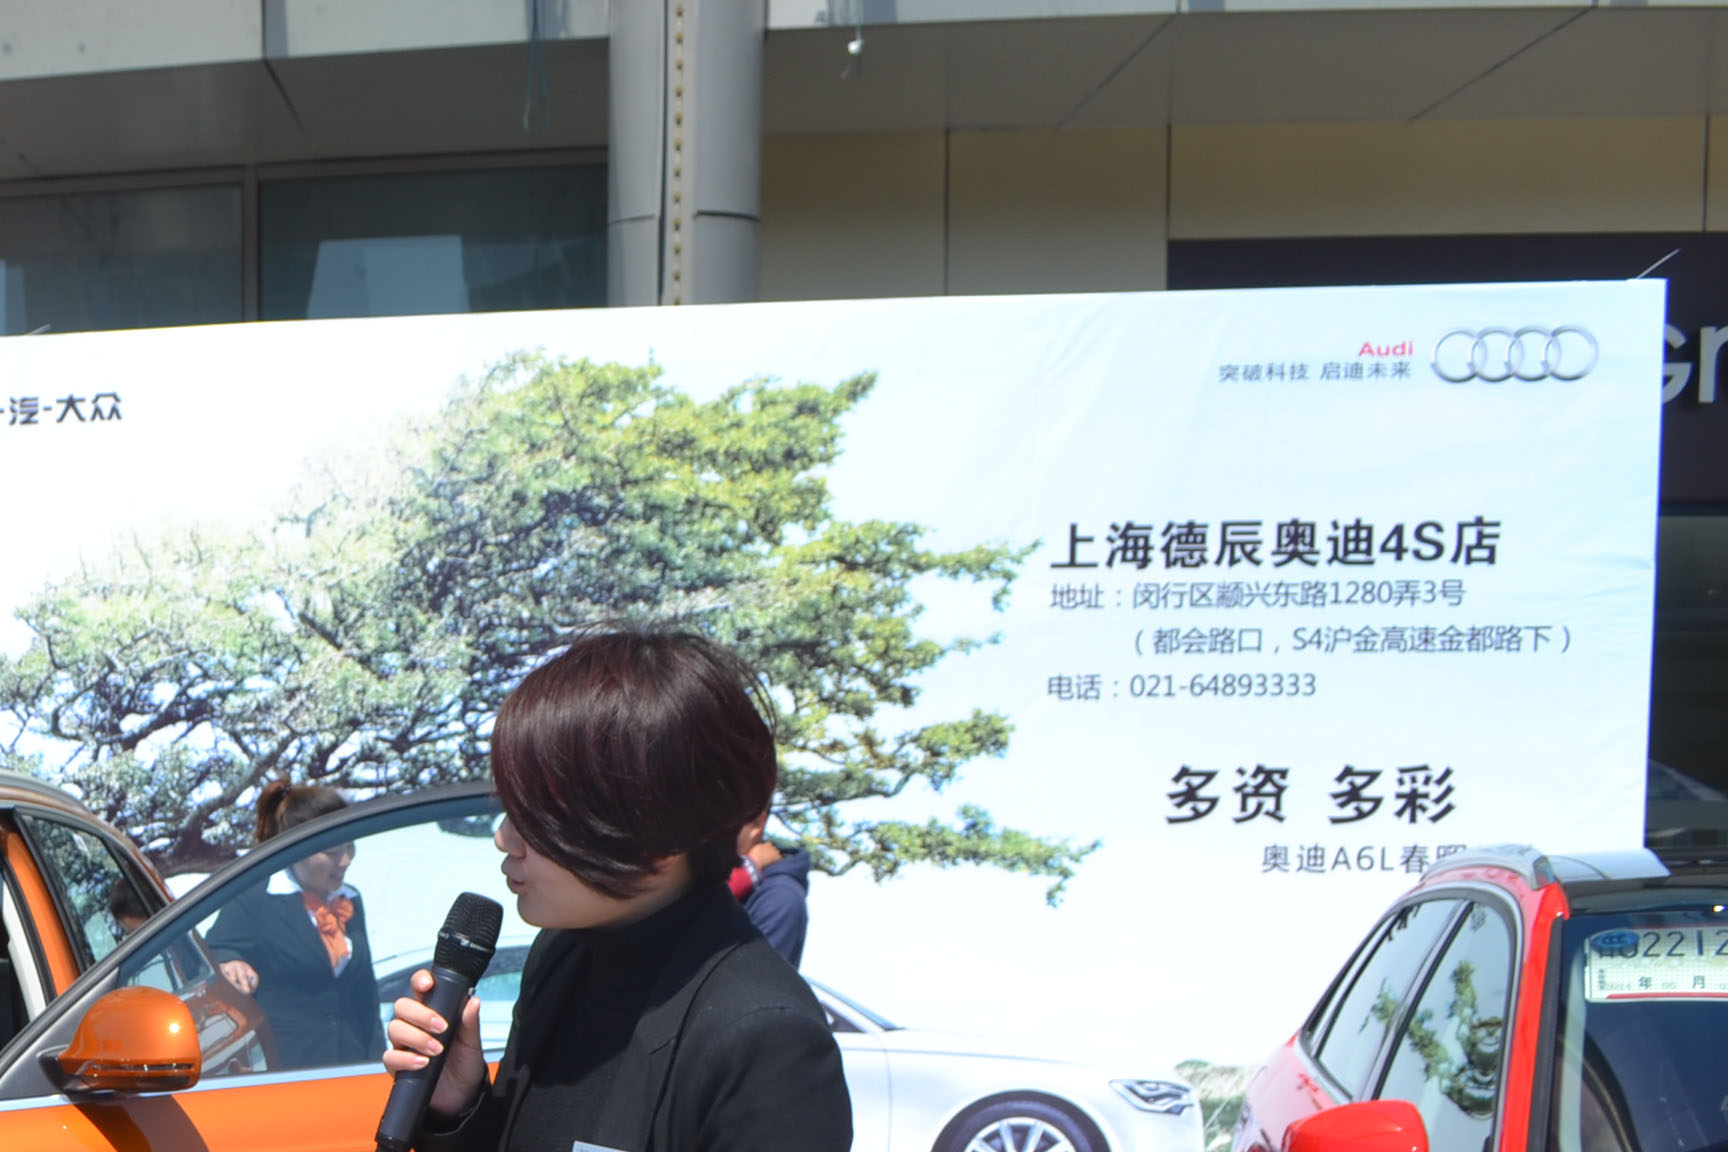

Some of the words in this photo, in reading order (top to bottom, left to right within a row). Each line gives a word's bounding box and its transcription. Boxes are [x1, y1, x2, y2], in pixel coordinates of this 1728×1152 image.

[1358, 341, 1414, 357] Audi
[1219, 363, 1310, 382] 突破科技
[1320, 361, 1412, 381] 启迪未来
[1050, 516, 1501, 570] 上海德辰奥迪4S店
[1166, 763, 1290, 824] 多资
[1328, 763, 1457, 824] 多彩
